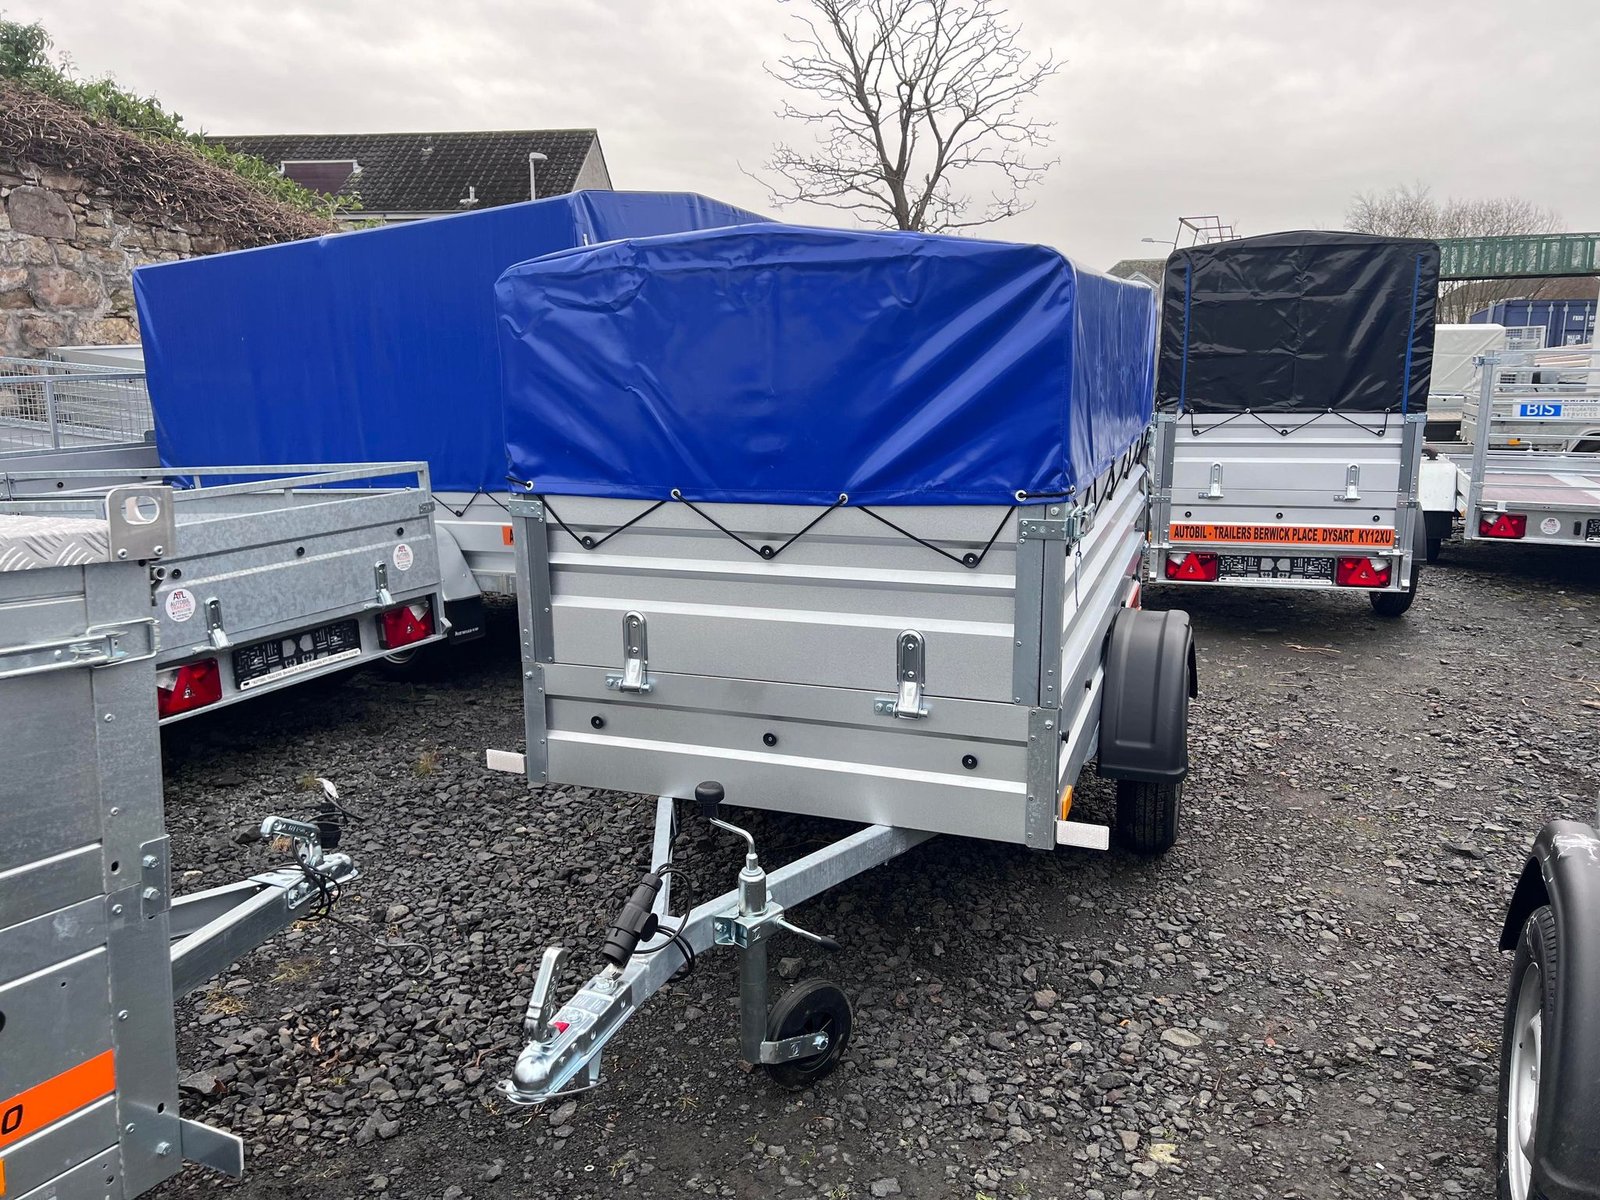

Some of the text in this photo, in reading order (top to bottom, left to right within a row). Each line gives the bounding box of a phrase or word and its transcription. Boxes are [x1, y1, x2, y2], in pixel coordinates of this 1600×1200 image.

[1526, 404, 1555, 415] BIS
[1174, 526, 1207, 539] AUTOBIL
[1214, 526, 1252, 540] TRAILERS
[1253, 527, 1290, 541] BERWICK
[1358, 530, 1392, 543] KY12XU
